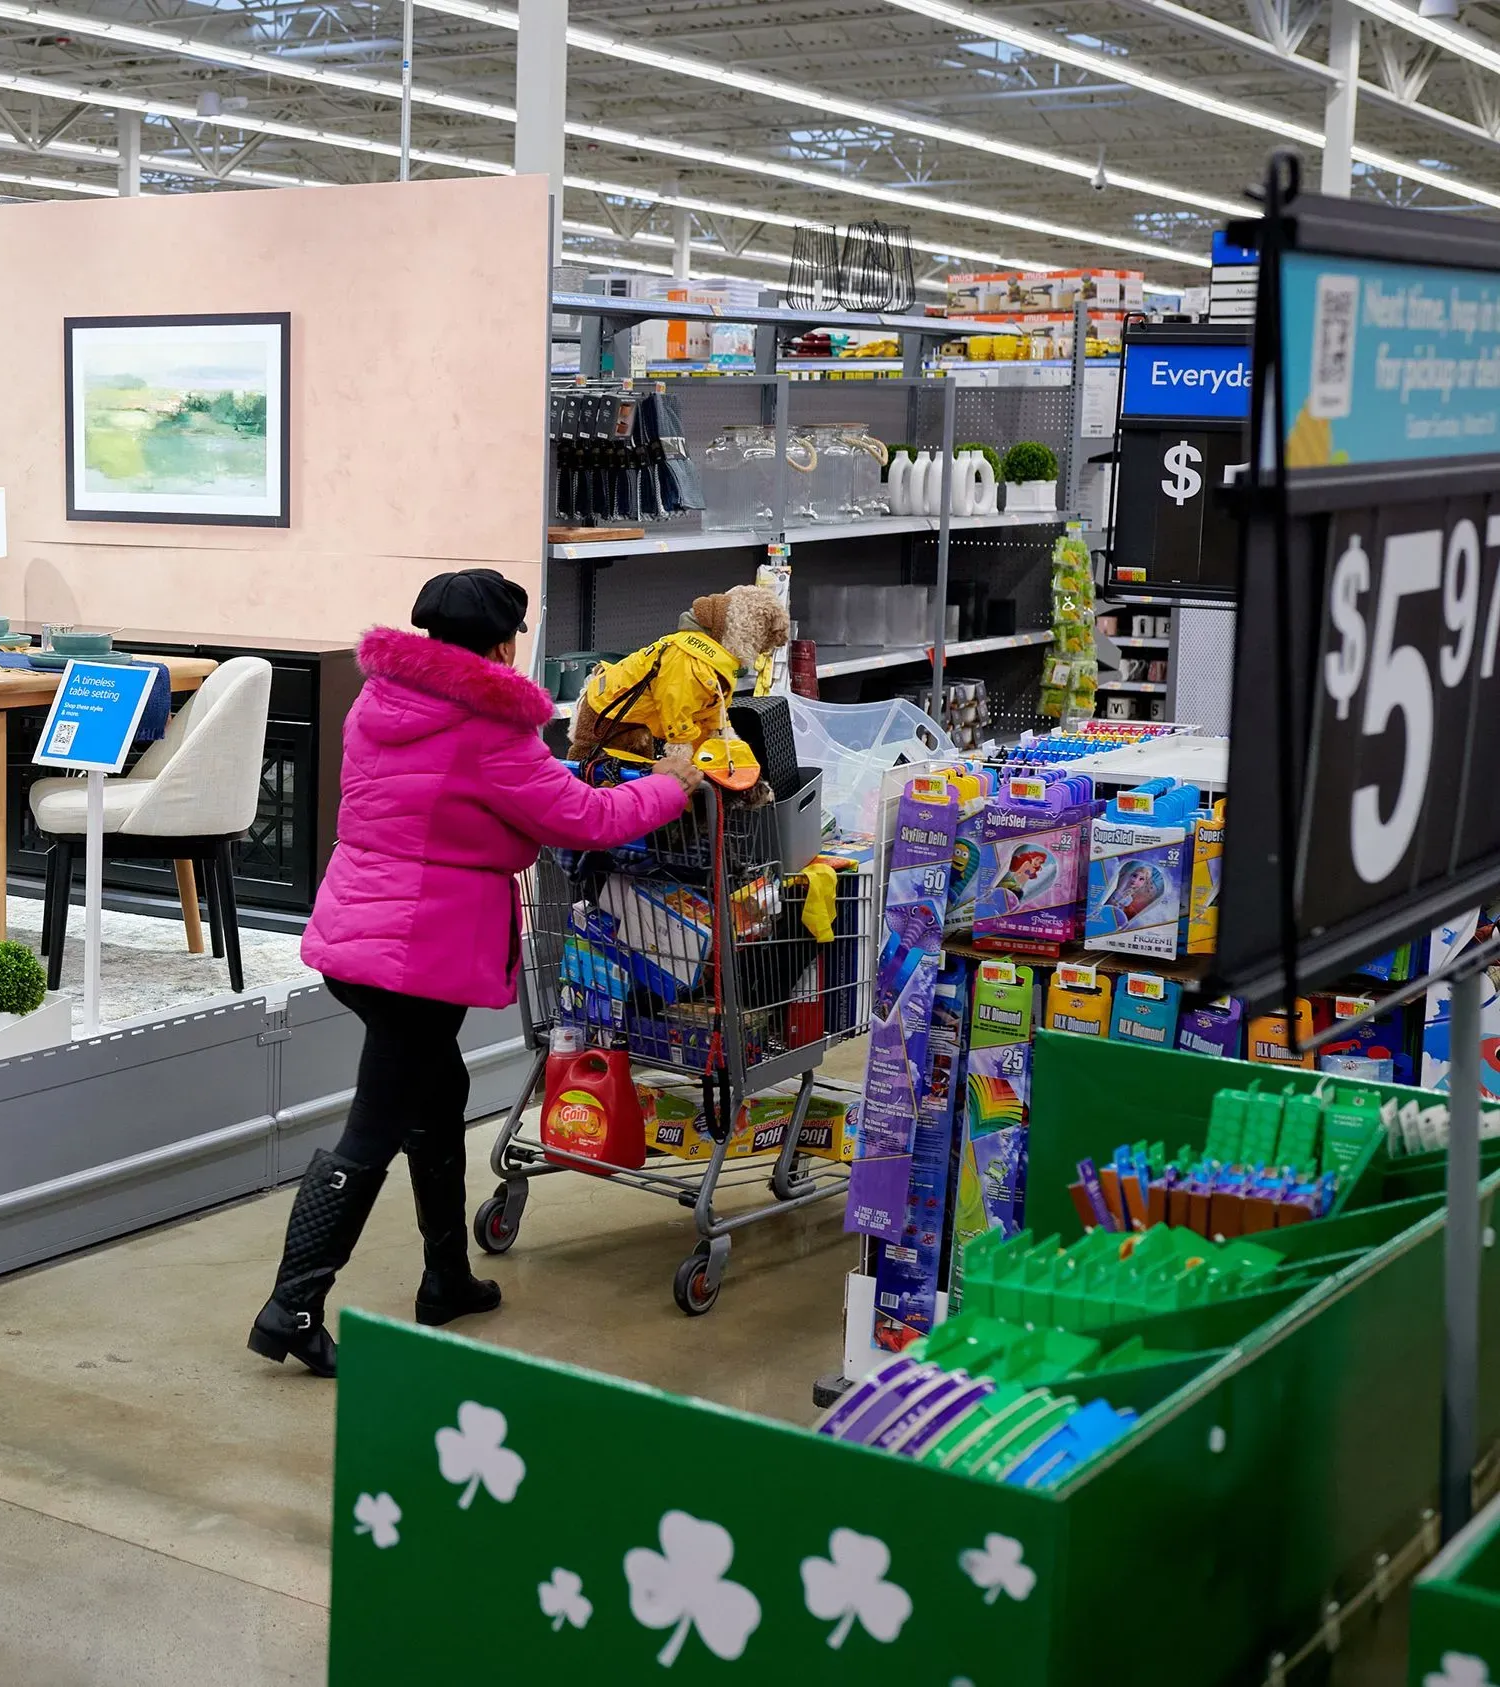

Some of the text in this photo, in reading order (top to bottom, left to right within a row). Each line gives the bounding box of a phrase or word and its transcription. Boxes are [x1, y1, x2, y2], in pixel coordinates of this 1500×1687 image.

[684, 635, 717, 658] NERVOUS
[72, 674, 115, 688] A timeless
[69, 686, 120, 702] table setting
[63, 702, 76, 710] Shop
[89, 704, 104, 712] styles
[1027, 785, 1039, 794] 797
[1135, 799, 1147, 807] 797
[986, 812, 1027, 829] SuperSled
[901, 827, 947, 847] SkyFlier Delta
[1060, 833, 1072, 845] 32
[1093, 827, 1134, 845] SuperSled
[1167, 850, 1180, 861] 32
[923, 869, 946, 890] 50
[1031, 915, 1063, 927] Princess
[1133, 935, 1165, 945] FROZEN
[979, 1004, 1022, 1026] DLX Diamond
[1053, 1014, 1100, 1035] DLX Diamond
[1118, 1018, 1165, 1043] DLX Diamond
[1180, 1029, 1224, 1057] DLX Diamond
[1256, 1041, 1269, 1057] DLX
[1001, 1048, 1024, 1070] 25
[561, 1104, 589, 1122] Gain
[658, 1128, 681, 1144] HUG
[754, 1126, 783, 1147] HUG
